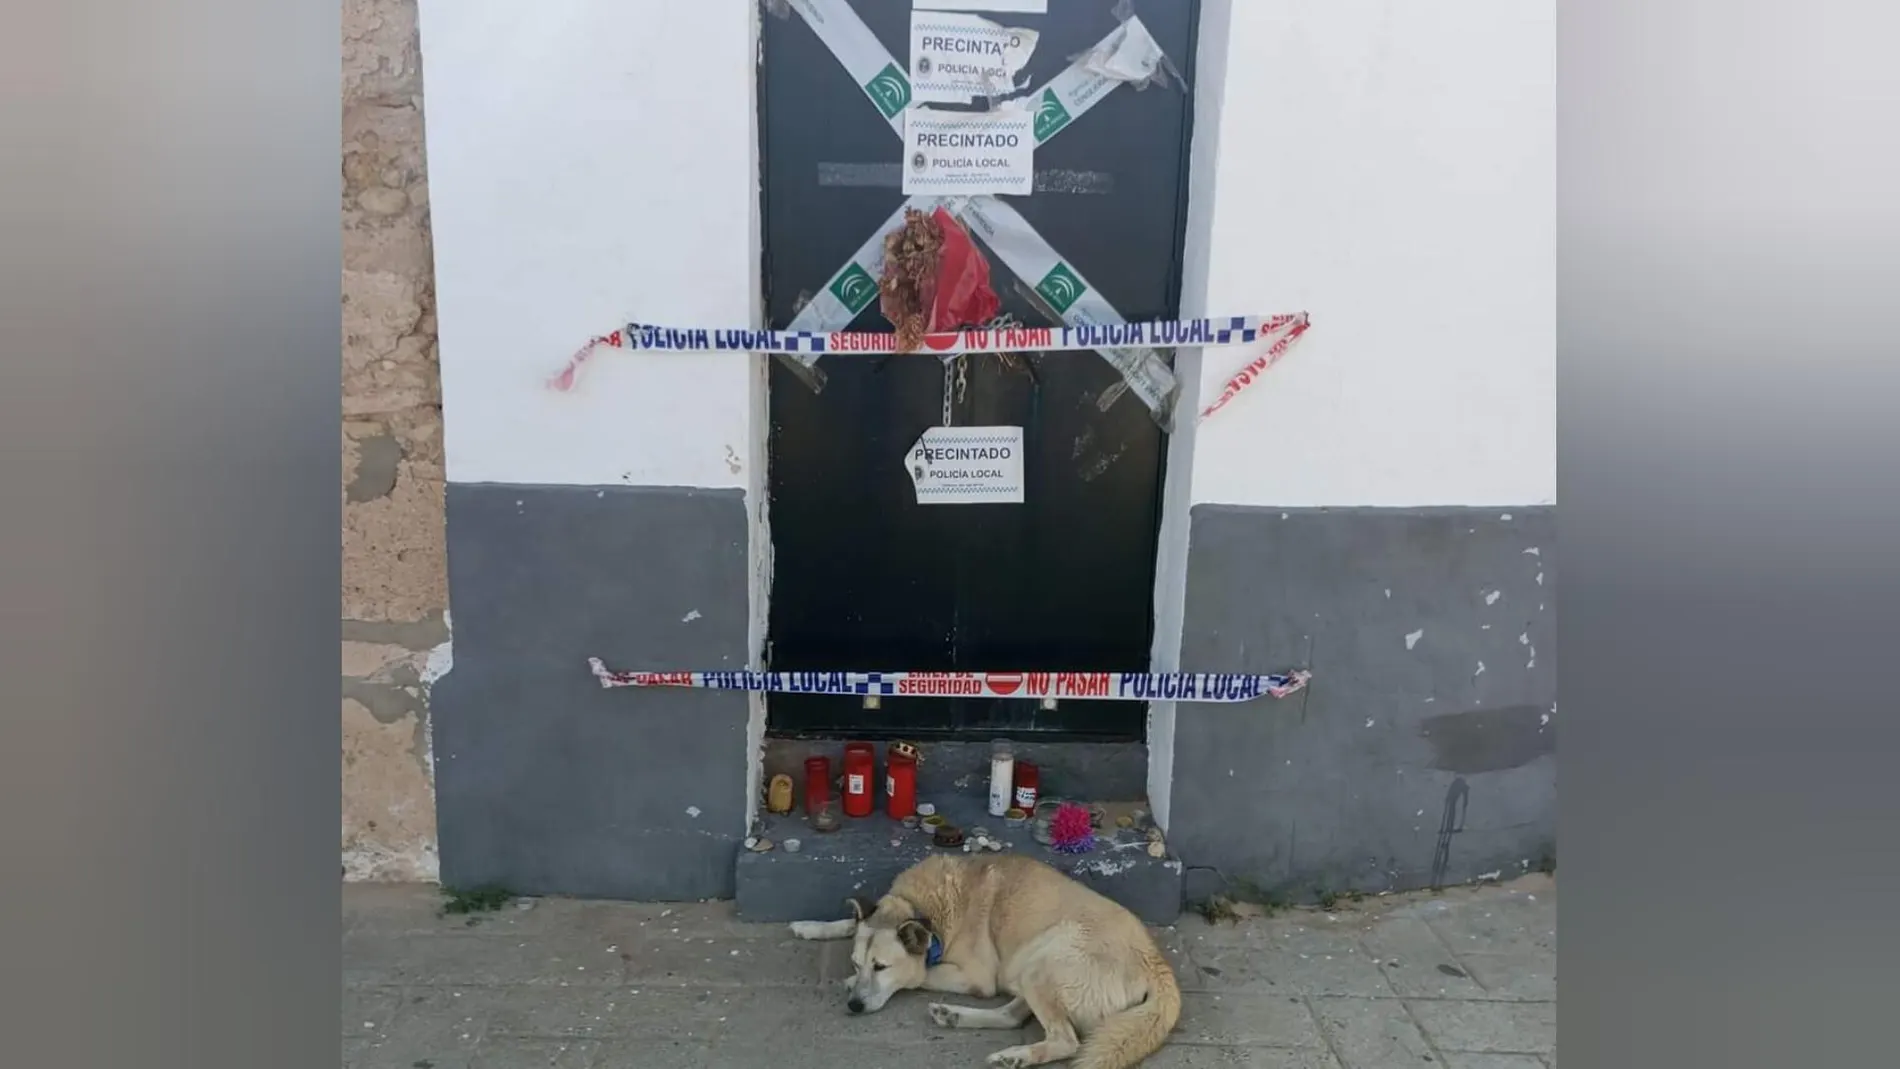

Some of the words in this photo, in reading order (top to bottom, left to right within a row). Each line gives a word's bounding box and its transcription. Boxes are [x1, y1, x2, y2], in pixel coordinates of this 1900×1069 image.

[922, 36, 1021, 55] PRECINTAO
[917, 133, 1019, 148] PRECINTADO
[975, 158, 1011, 168] LOCAL
[715, 329, 782, 351] LOCAL
[964, 328, 989, 349] NO
[1149, 318, 1215, 345] LOCAL
[830, 332, 897, 351] SEGURID
[914, 447, 1012, 461] PRECINTADO
[970, 469, 1003, 478] LOCAL
[790, 671, 852, 693] LOCAL
[899, 679, 982, 694] SEGURIDAD
[1026, 671, 1050, 695] NO
[1055, 671, 1110, 696] PASAR
[1201, 673, 1264, 699] LOCAL
